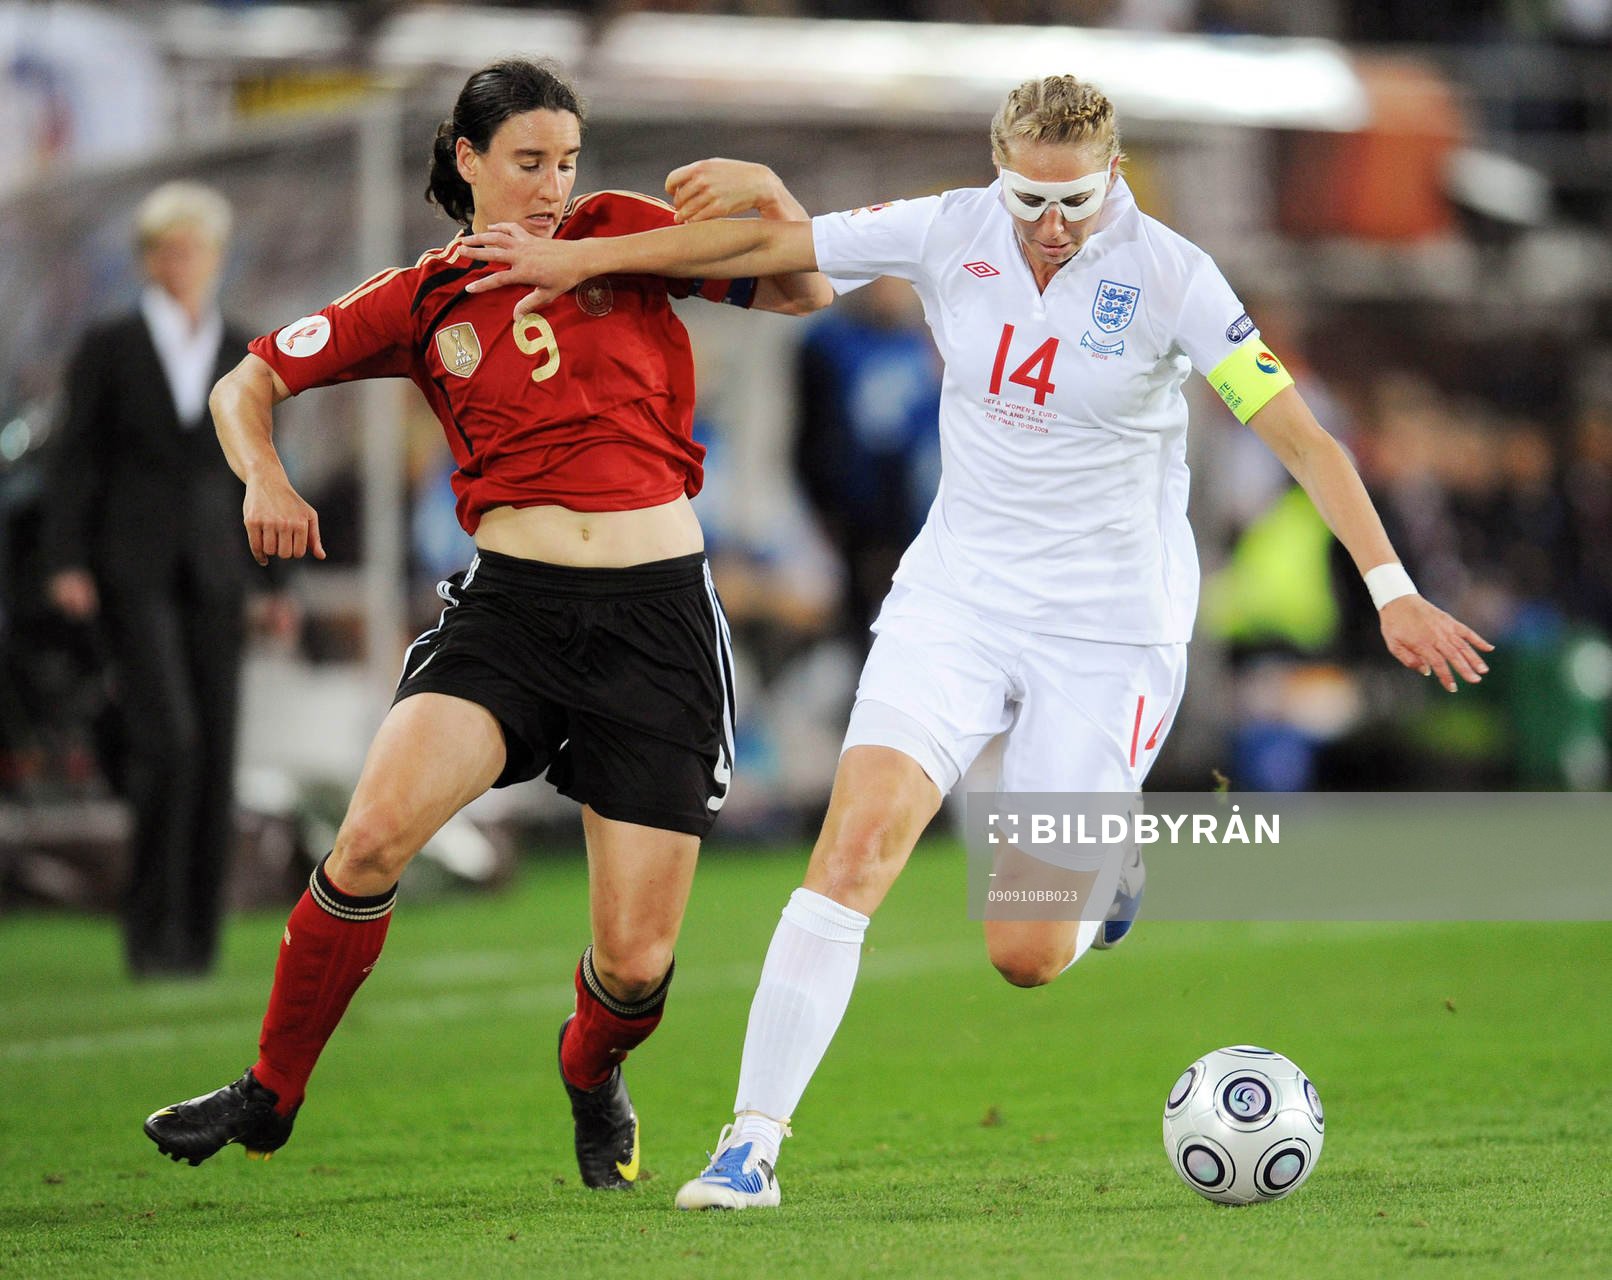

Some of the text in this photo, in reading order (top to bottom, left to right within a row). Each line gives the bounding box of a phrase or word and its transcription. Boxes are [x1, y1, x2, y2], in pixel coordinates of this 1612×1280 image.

[513, 313, 561, 383] 9
[455, 354, 473, 367] FIFA
[989, 323, 1060, 406] 14
[983, 397, 1001, 406] UEFA
[1039, 410, 1058, 419] EURO
[995, 408, 1024, 419] FINLAND
[985, 411, 997, 421] THE
[998, 416, 1015, 427] FINAL
